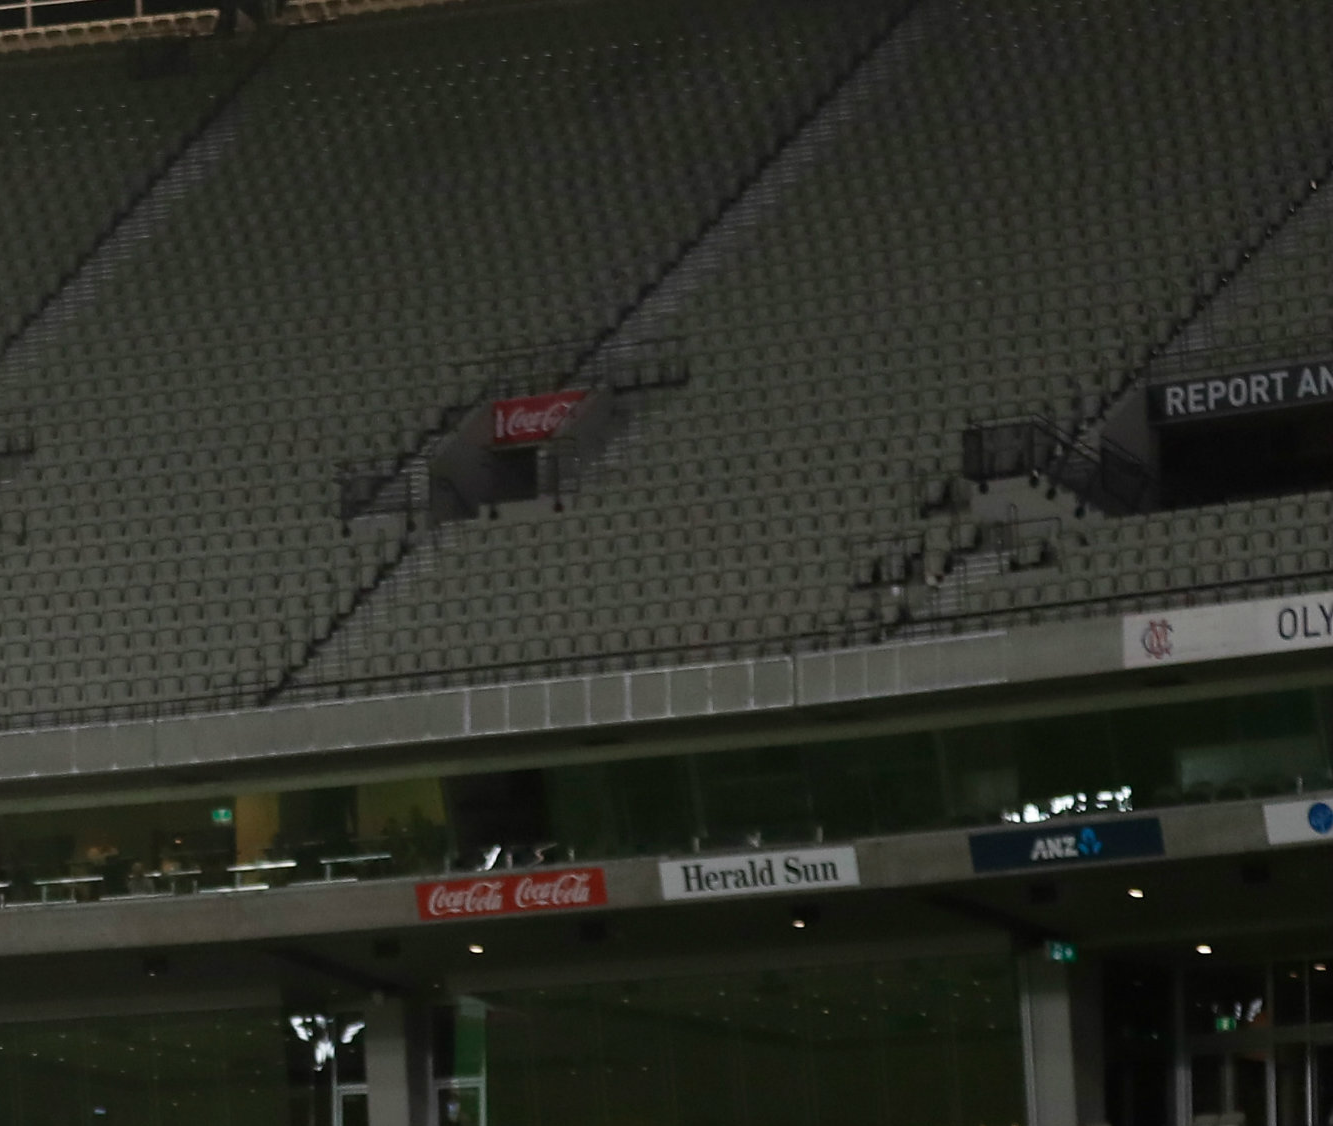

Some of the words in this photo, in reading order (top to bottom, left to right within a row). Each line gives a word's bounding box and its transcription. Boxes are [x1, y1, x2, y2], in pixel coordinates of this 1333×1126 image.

[1165, 371, 1289, 417] REPORT
[1031, 835, 1079, 861] ANZ
[683, 860, 775, 892] Herald
[784, 856, 839, 884] Sun
